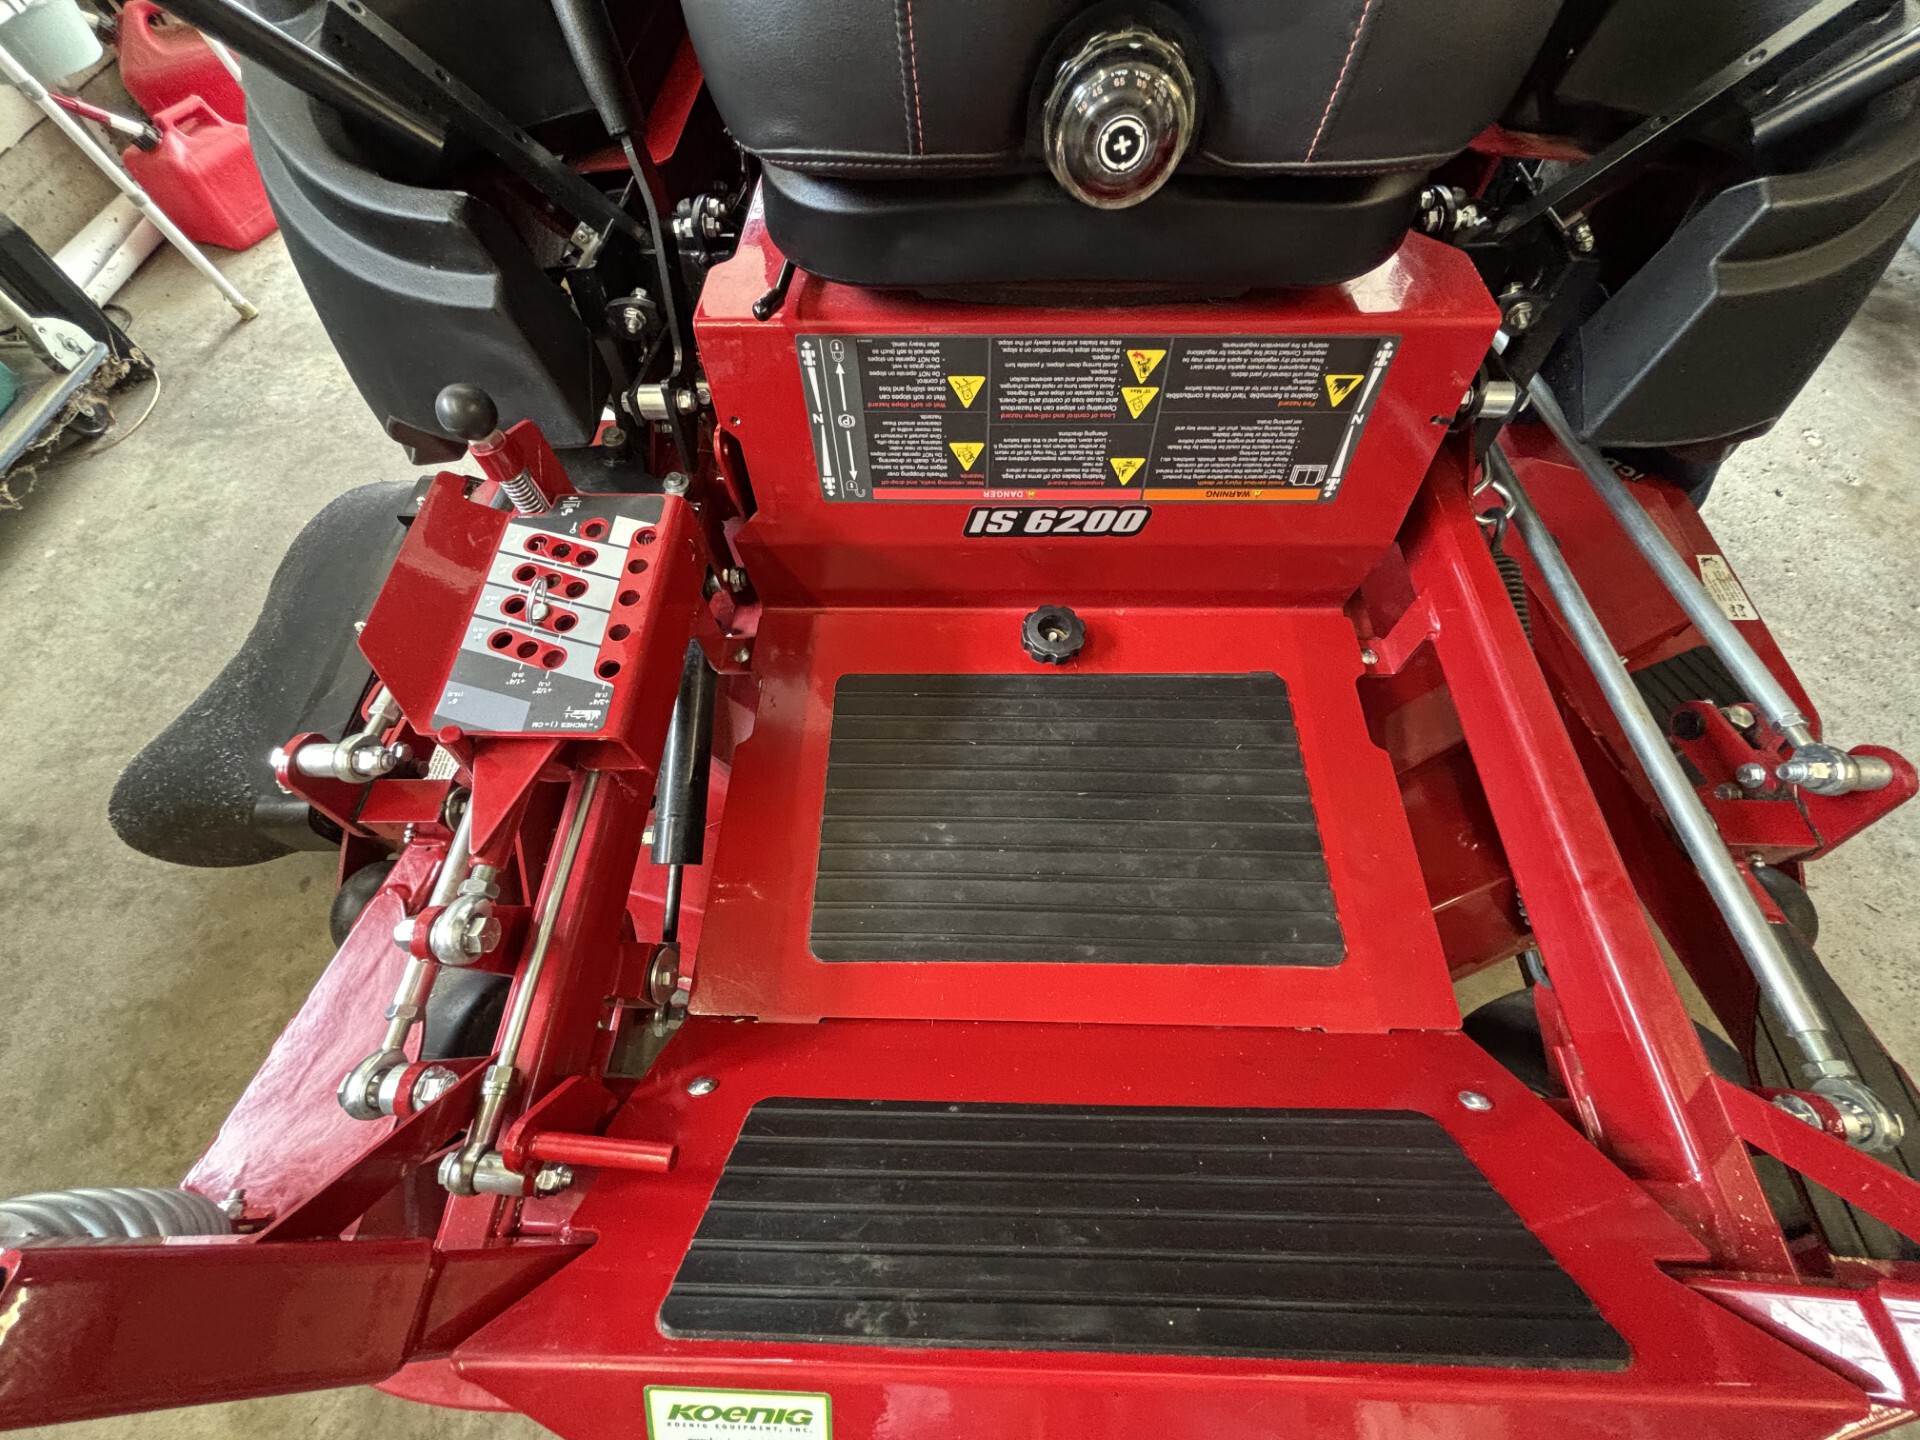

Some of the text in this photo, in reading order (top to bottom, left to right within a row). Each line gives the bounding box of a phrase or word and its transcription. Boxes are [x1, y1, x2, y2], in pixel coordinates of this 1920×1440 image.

[1114, 76, 1125, 87] 65
[812, 414, 823, 424] N
[1352, 414, 1364, 424] N
[968, 510, 1148, 533] IS 6200
[716, 1424, 782, 1432] EQUIPMENT,
